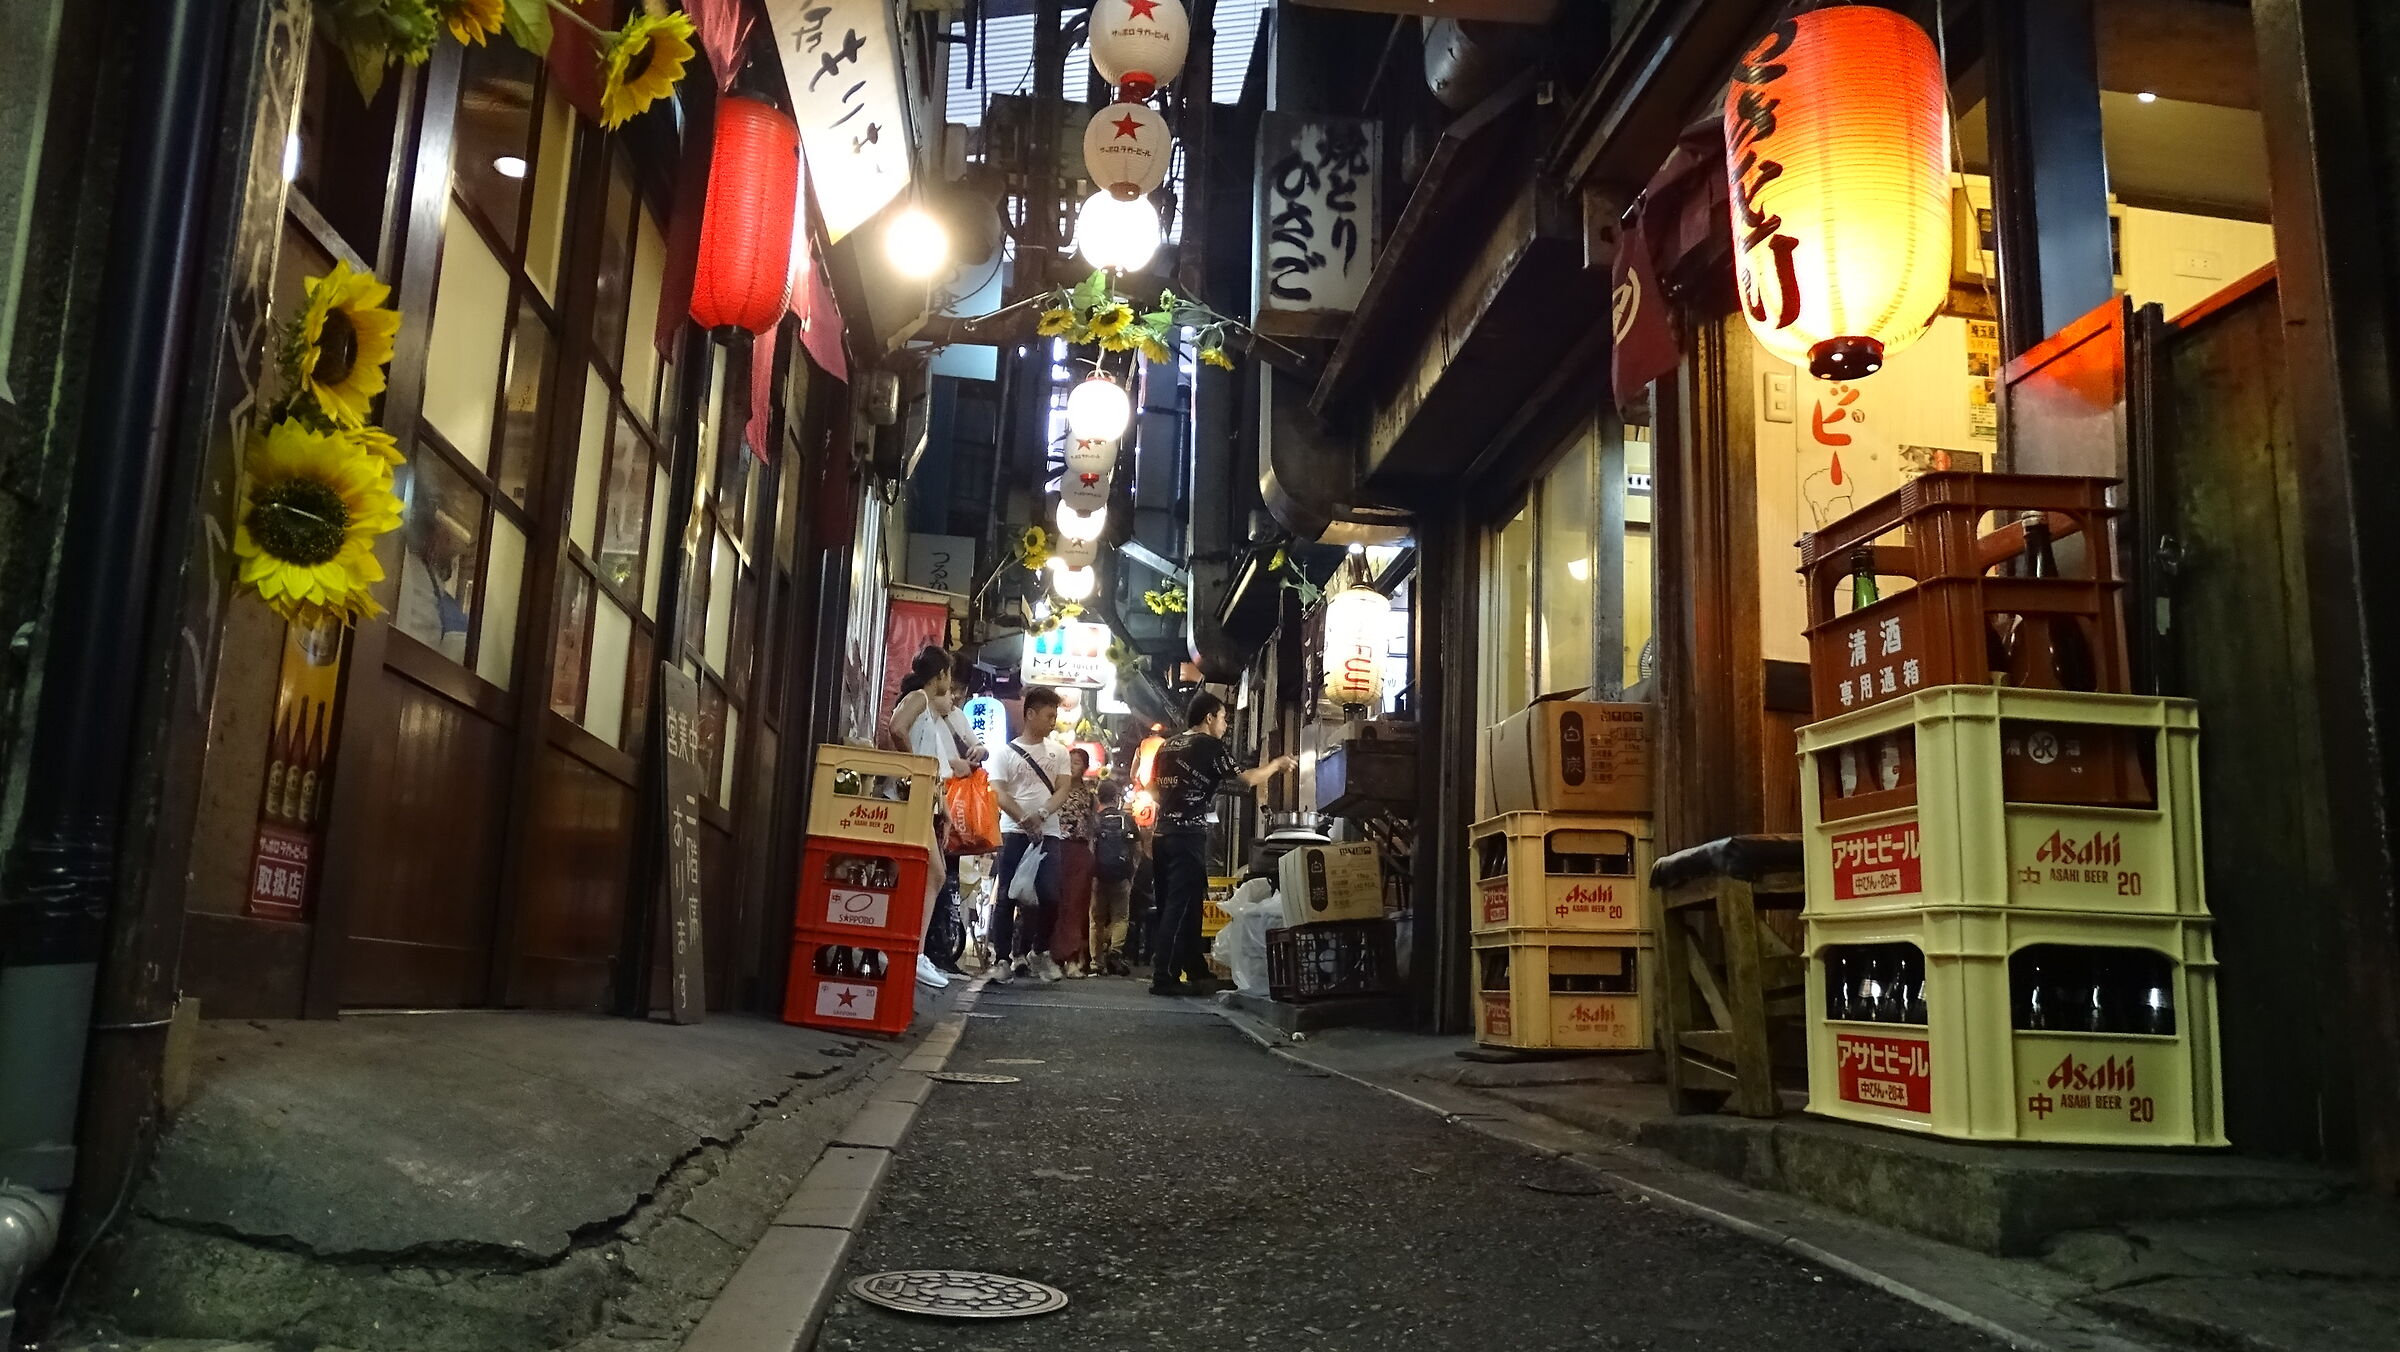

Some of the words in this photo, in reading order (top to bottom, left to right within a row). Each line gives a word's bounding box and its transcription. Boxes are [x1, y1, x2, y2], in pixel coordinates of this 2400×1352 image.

[1848, 616, 1902, 667] 清酒
[1033, 656, 1067, 668] トイレ
[1839, 658, 1920, 706] 専用通箱
[667, 706, 698, 765] 営業中
[840, 818, 851, 830] 中
[849, 804, 889, 821] Asahi
[883, 823, 895, 834] 20
[1833, 830, 1921, 869] アサヒビール
[2036, 829, 2121, 867] Asahi
[257, 864, 302, 900] 取扱店
[2049, 868, 2080, 883] ASAHI
[2084, 869, 2109, 884] BEER
[2117, 872, 2142, 896] 20
[1566, 884, 1613, 904] Asahi
[1556, 904, 1569, 919] 中
[1609, 905, 1623, 919] 20
[1568, 1002, 1616, 1024] Asahi
[1838, 1040, 1928, 1077] アサヒビール
[2047, 1052, 2135, 1091] Asahi
[2028, 1092, 2053, 1120] 中
[2060, 1094, 2091, 1109] ASAHI
[2095, 1095, 2123, 1110] BEER
[2129, 1096, 2154, 1123] 20
